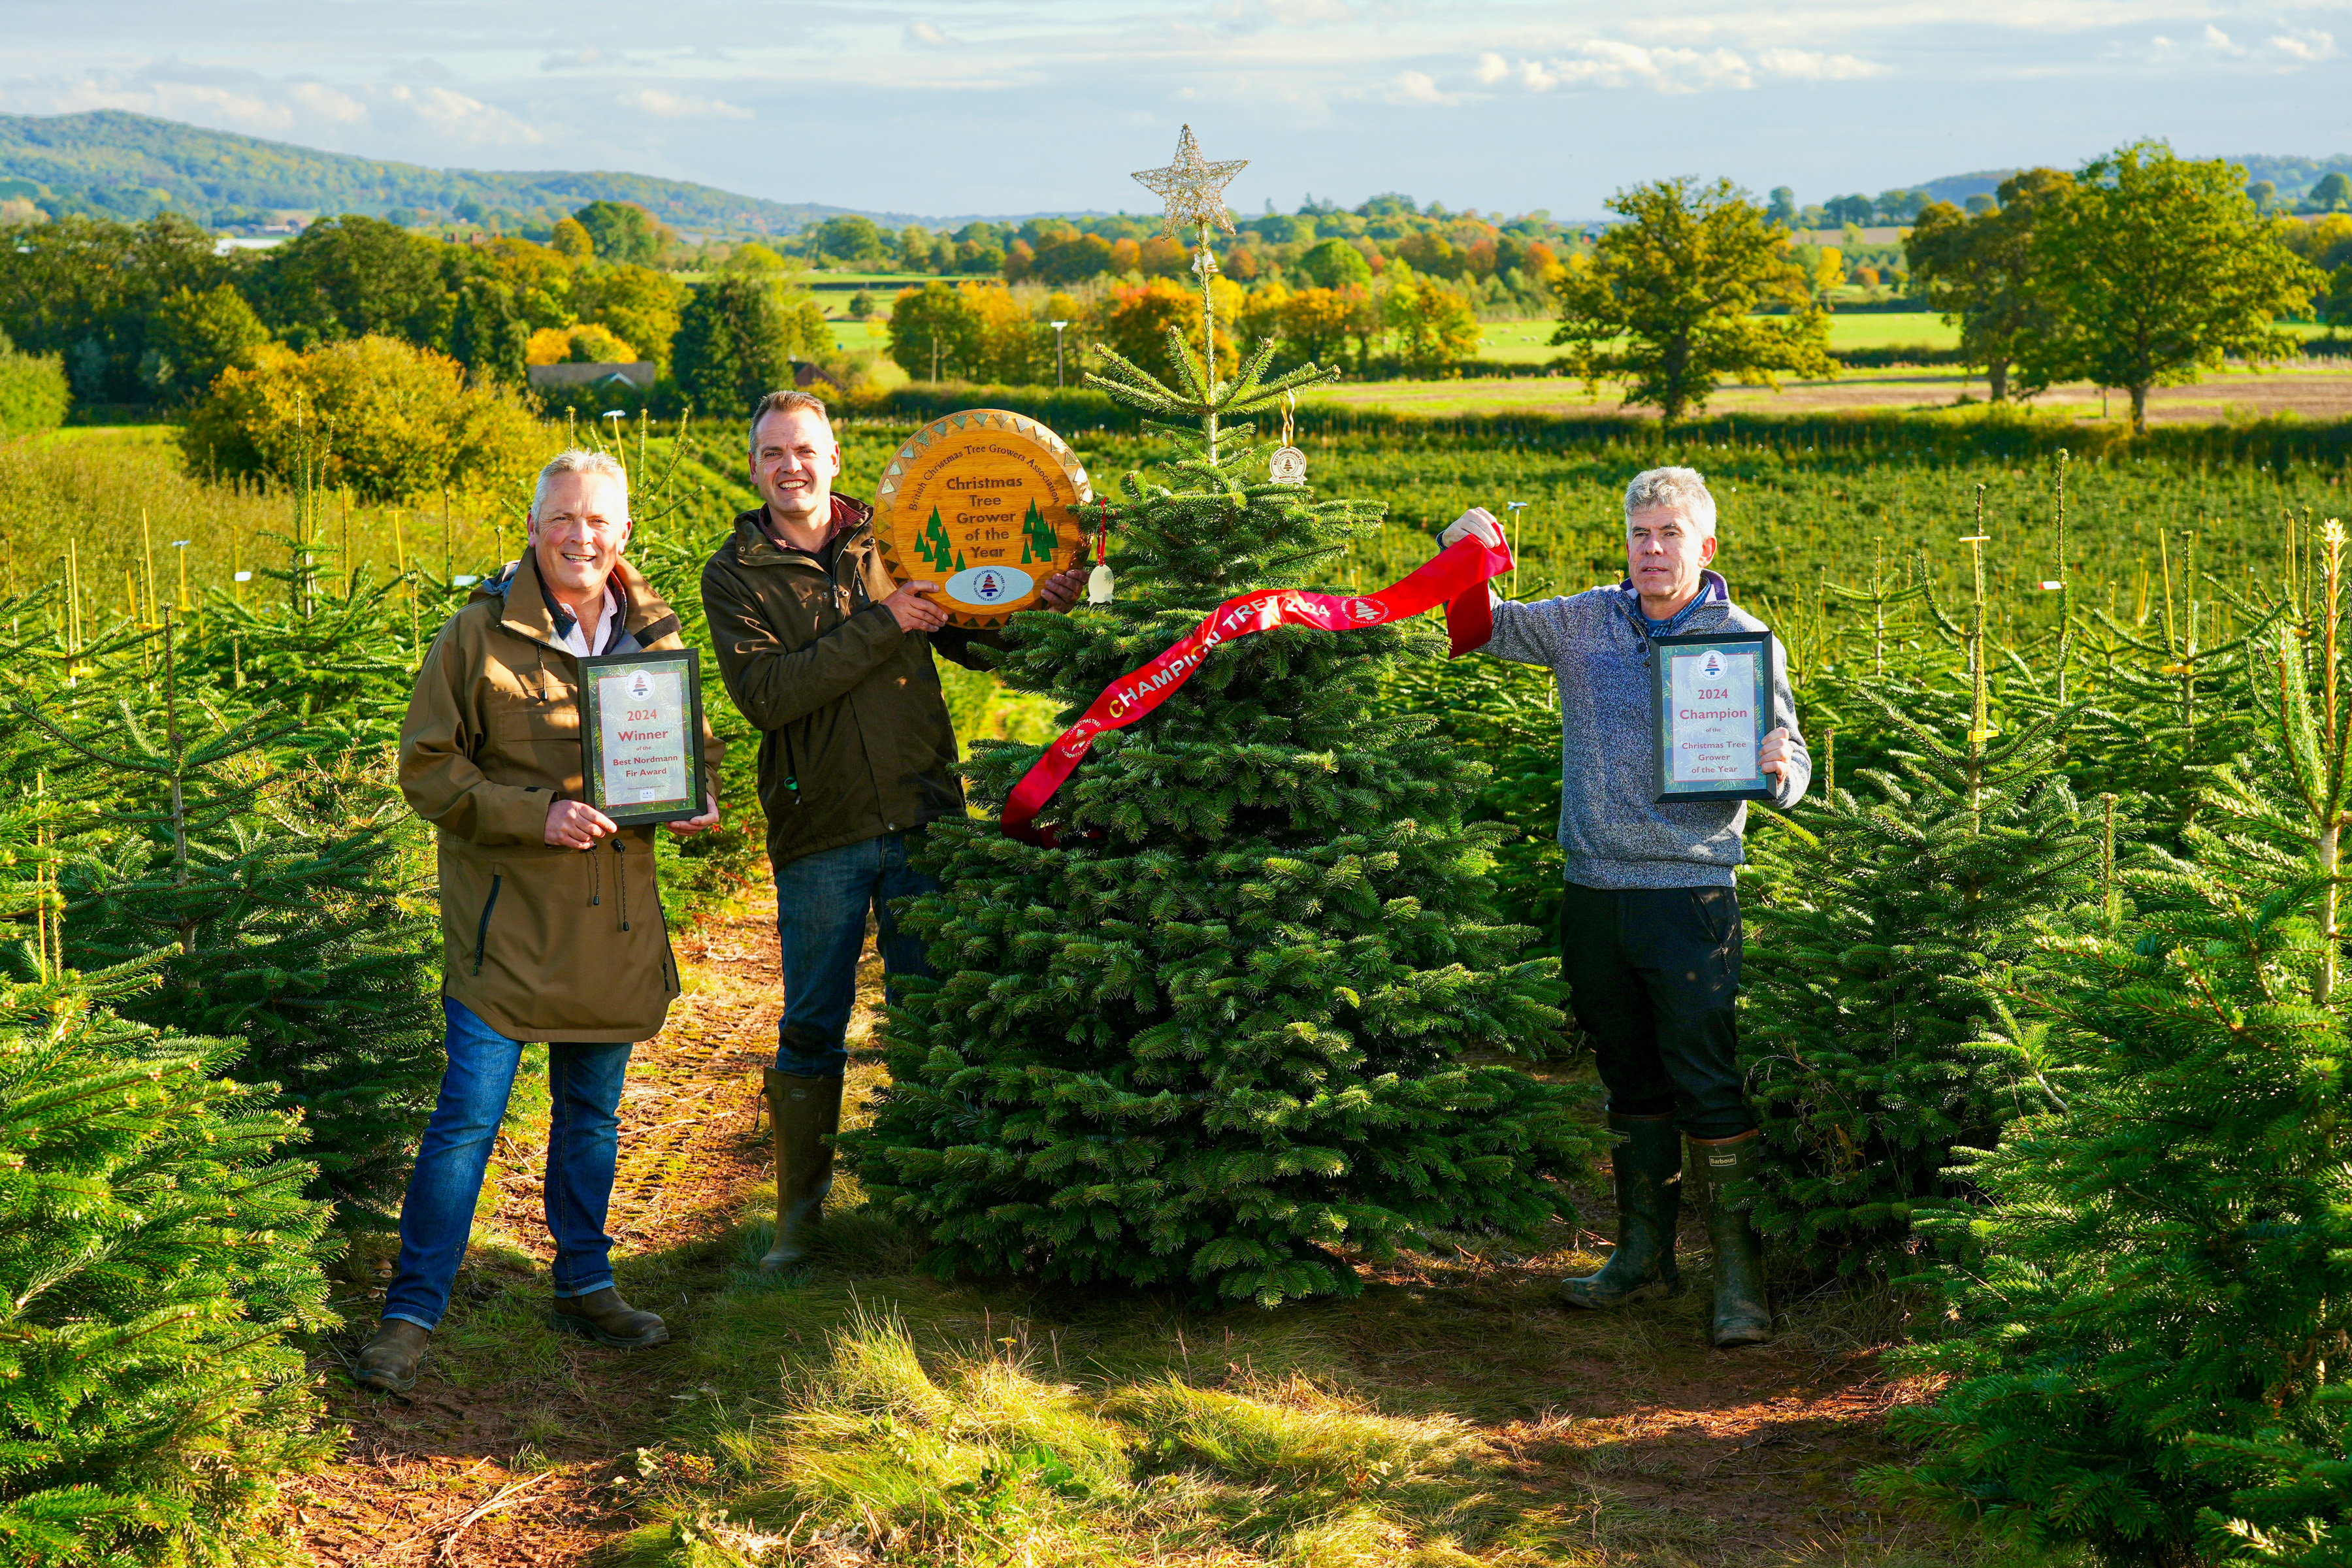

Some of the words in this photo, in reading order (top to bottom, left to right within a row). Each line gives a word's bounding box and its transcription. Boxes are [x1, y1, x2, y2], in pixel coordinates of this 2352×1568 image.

[1279, 450, 1300, 459] NORDMANN
[909, 482, 927, 511] British
[924, 451, 963, 480] Christmas
[964, 445, 986, 454] Tree
[989, 444, 1026, 462] Growers
[1026, 459, 1060, 503] Association
[947, 476, 1023, 490] Christmas
[969, 495, 1002, 507] Tree
[956, 512, 1017, 524] Grower
[965, 528, 980, 542] of
[985, 527, 1009, 541] the
[970, 546, 1005, 559] Year
[974, 587, 987, 600] GROWERS
[987, 586, 1005, 601] ASSOCIATION
[1109, 630, 1221, 718] CHAMPION
[1698, 689, 1728, 699] 2024
[627, 709, 657, 721] 2024
[1680, 708, 1747, 721] Champion
[1069, 718, 1091, 735] CHRISTMAS
[1092, 719, 1101, 728] TREE
[618, 730, 668, 742] Winner
[634, 756, 678, 764] Nordmann
[1064, 750, 1083, 758] GROWERS
[640, 767, 667, 776] Award
